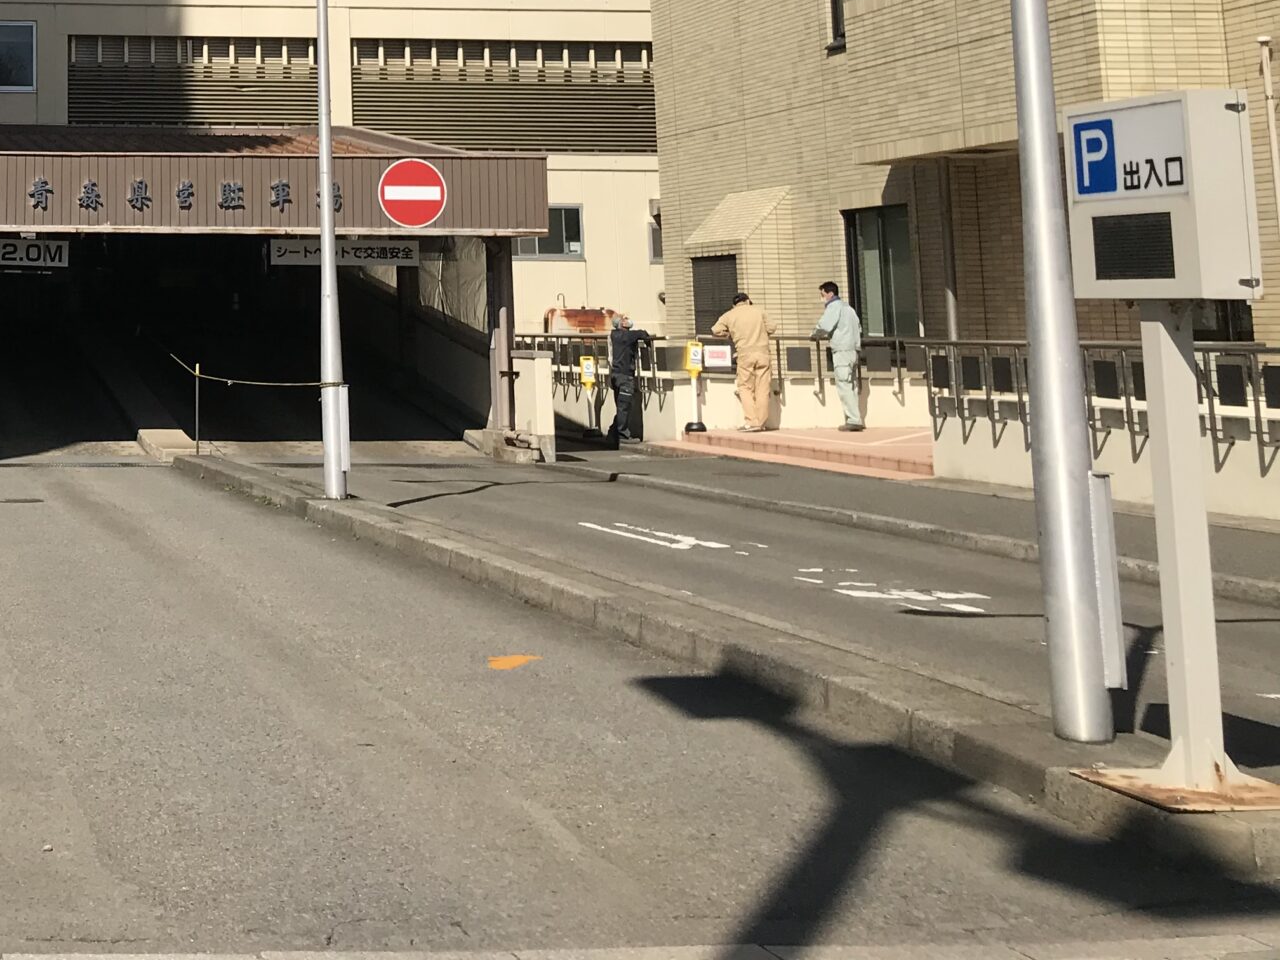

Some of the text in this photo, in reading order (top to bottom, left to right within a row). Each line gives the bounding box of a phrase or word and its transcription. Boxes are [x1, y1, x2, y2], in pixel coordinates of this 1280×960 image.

[1080, 128, 1108, 187] P
[1123, 156, 1185, 190] 出入口
[276, 245, 414, 260] シートトで交通安全
